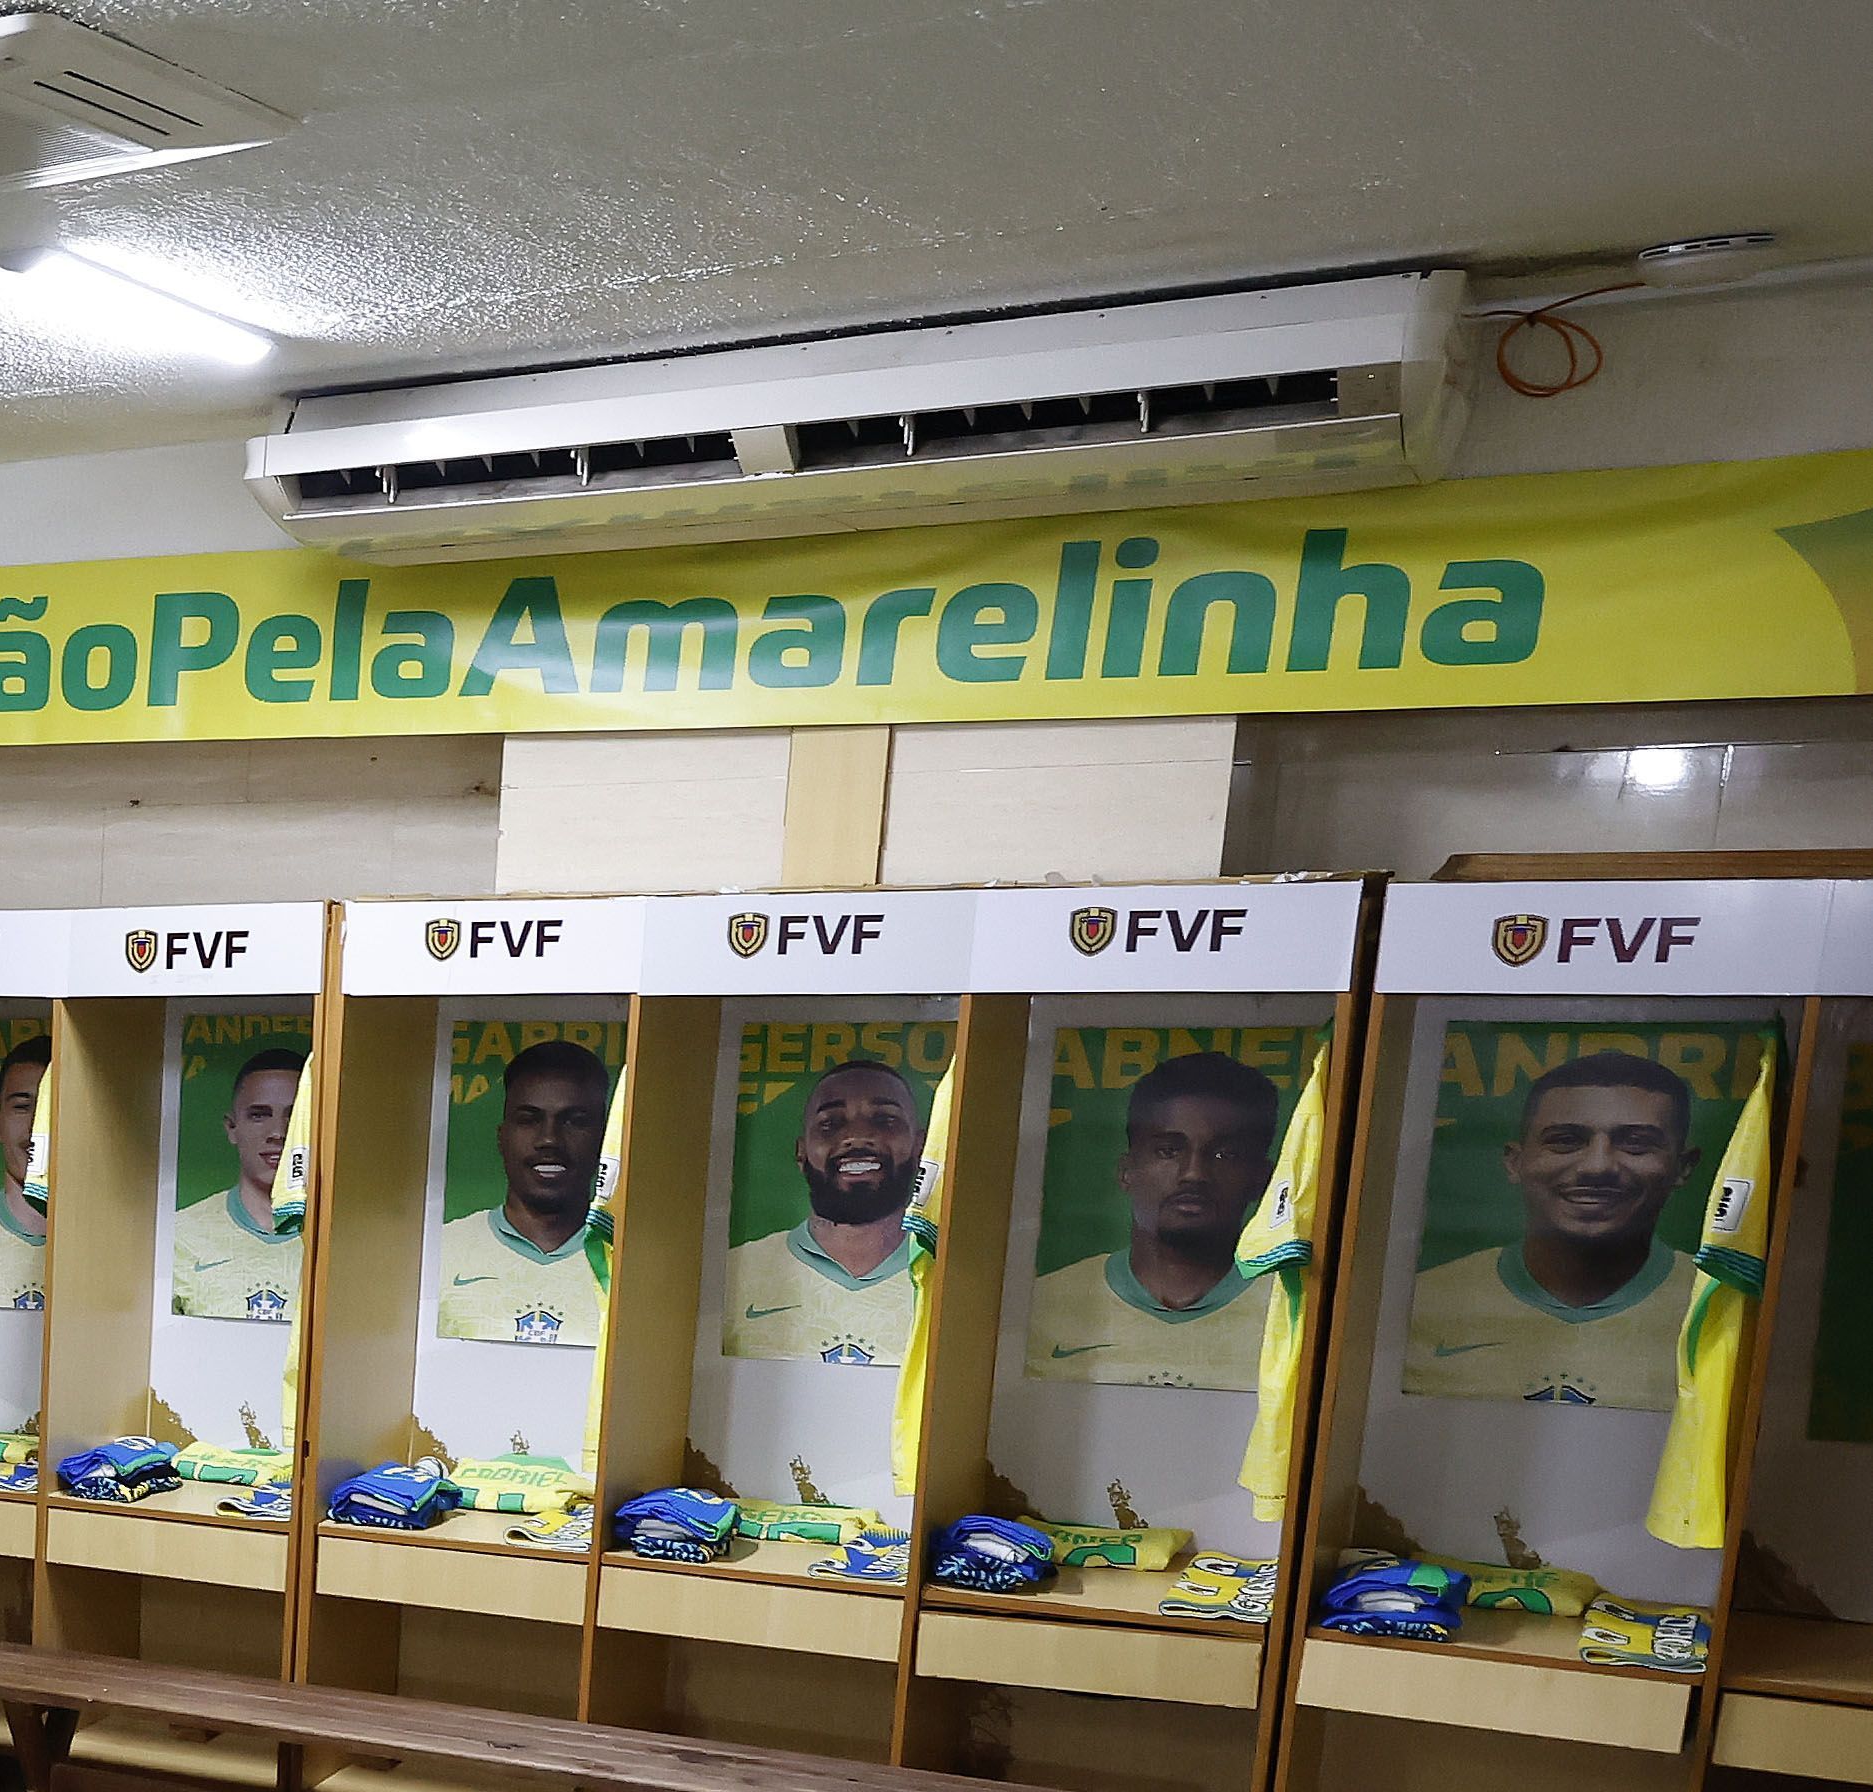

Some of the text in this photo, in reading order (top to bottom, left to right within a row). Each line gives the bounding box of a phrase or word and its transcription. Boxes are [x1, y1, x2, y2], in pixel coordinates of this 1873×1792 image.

[165, 930, 250, 970] FVF
[469, 919, 563, 959] FVF
[777, 914, 885, 955] FVF
[1125, 908, 1248, 953] FVF
[1556, 917, 1701, 964] FVF
